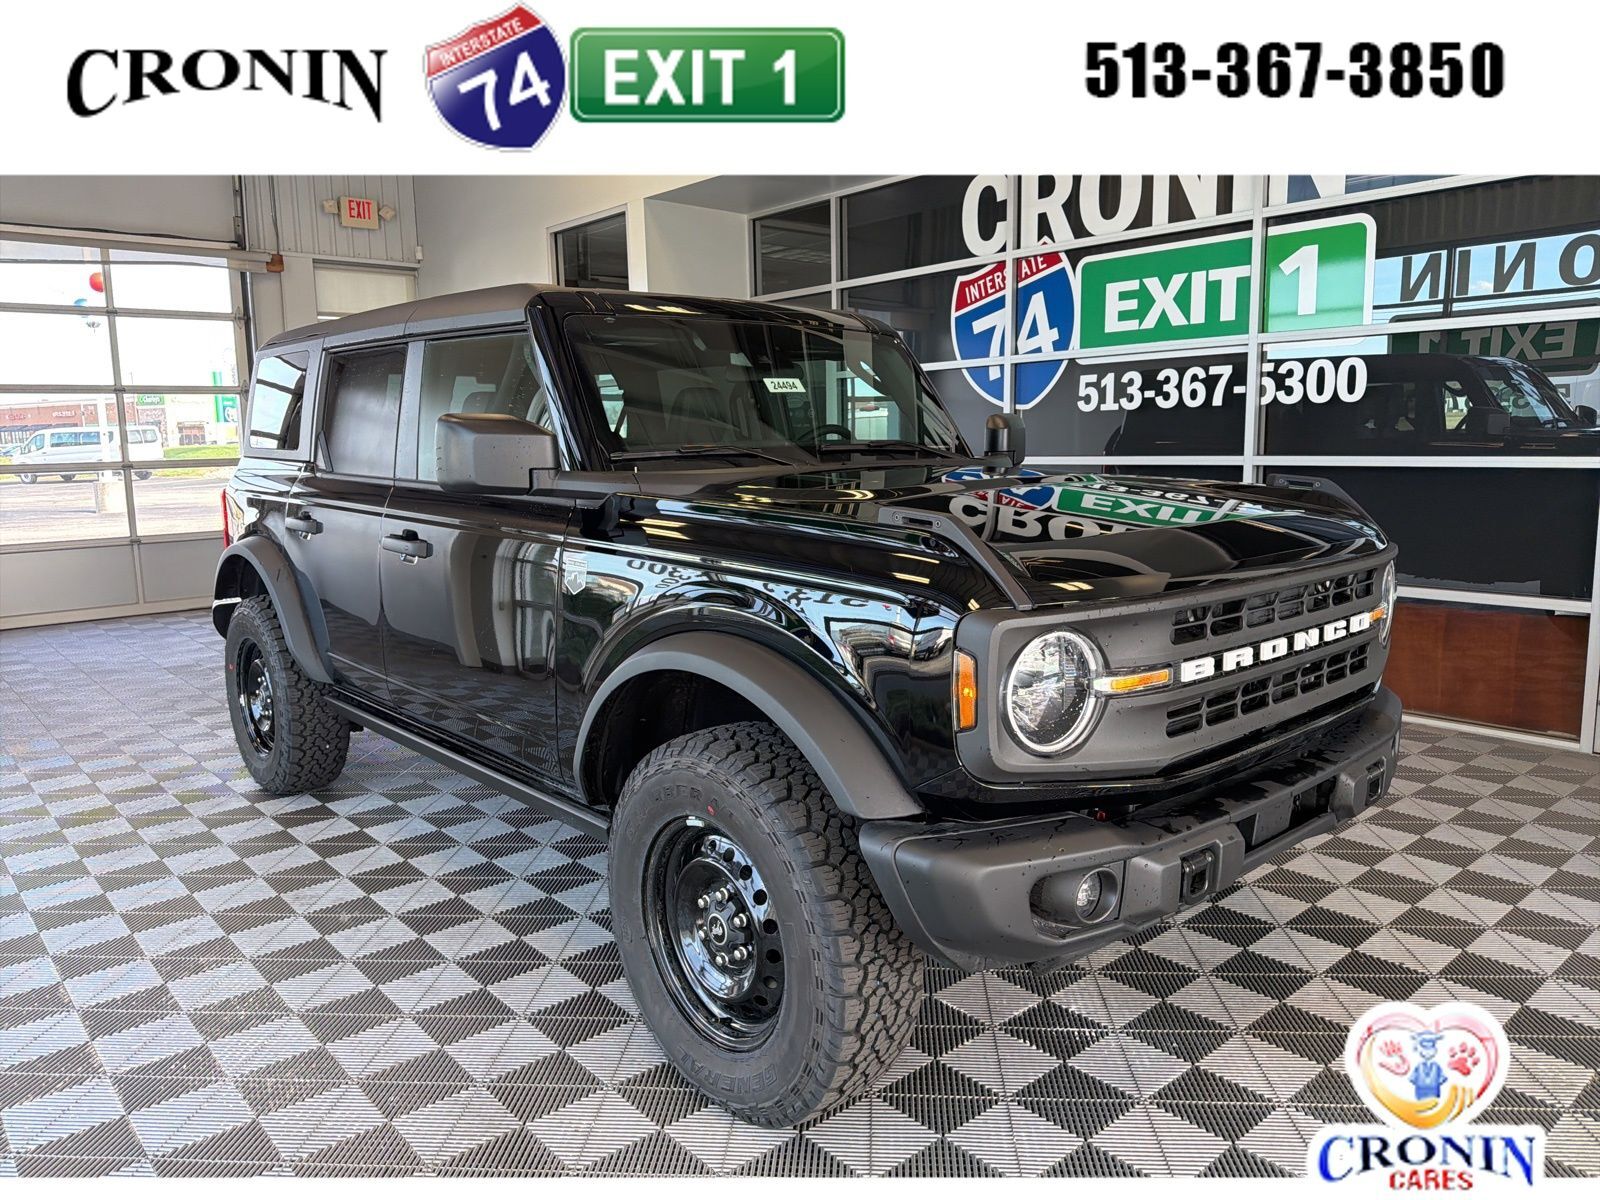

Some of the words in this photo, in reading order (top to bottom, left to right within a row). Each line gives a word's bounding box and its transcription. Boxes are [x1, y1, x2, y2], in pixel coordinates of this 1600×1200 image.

[347, 199, 373, 220] EXIT
[1104, 264, 1251, 334] EXIT
[1279, 244, 1320, 316] 1
[971, 290, 1060, 381] 74
[769, 380, 799, 391] 24494
[1077, 357, 1367, 413] 513-367-5300
[1181, 612, 1370, 683] BRONCO
